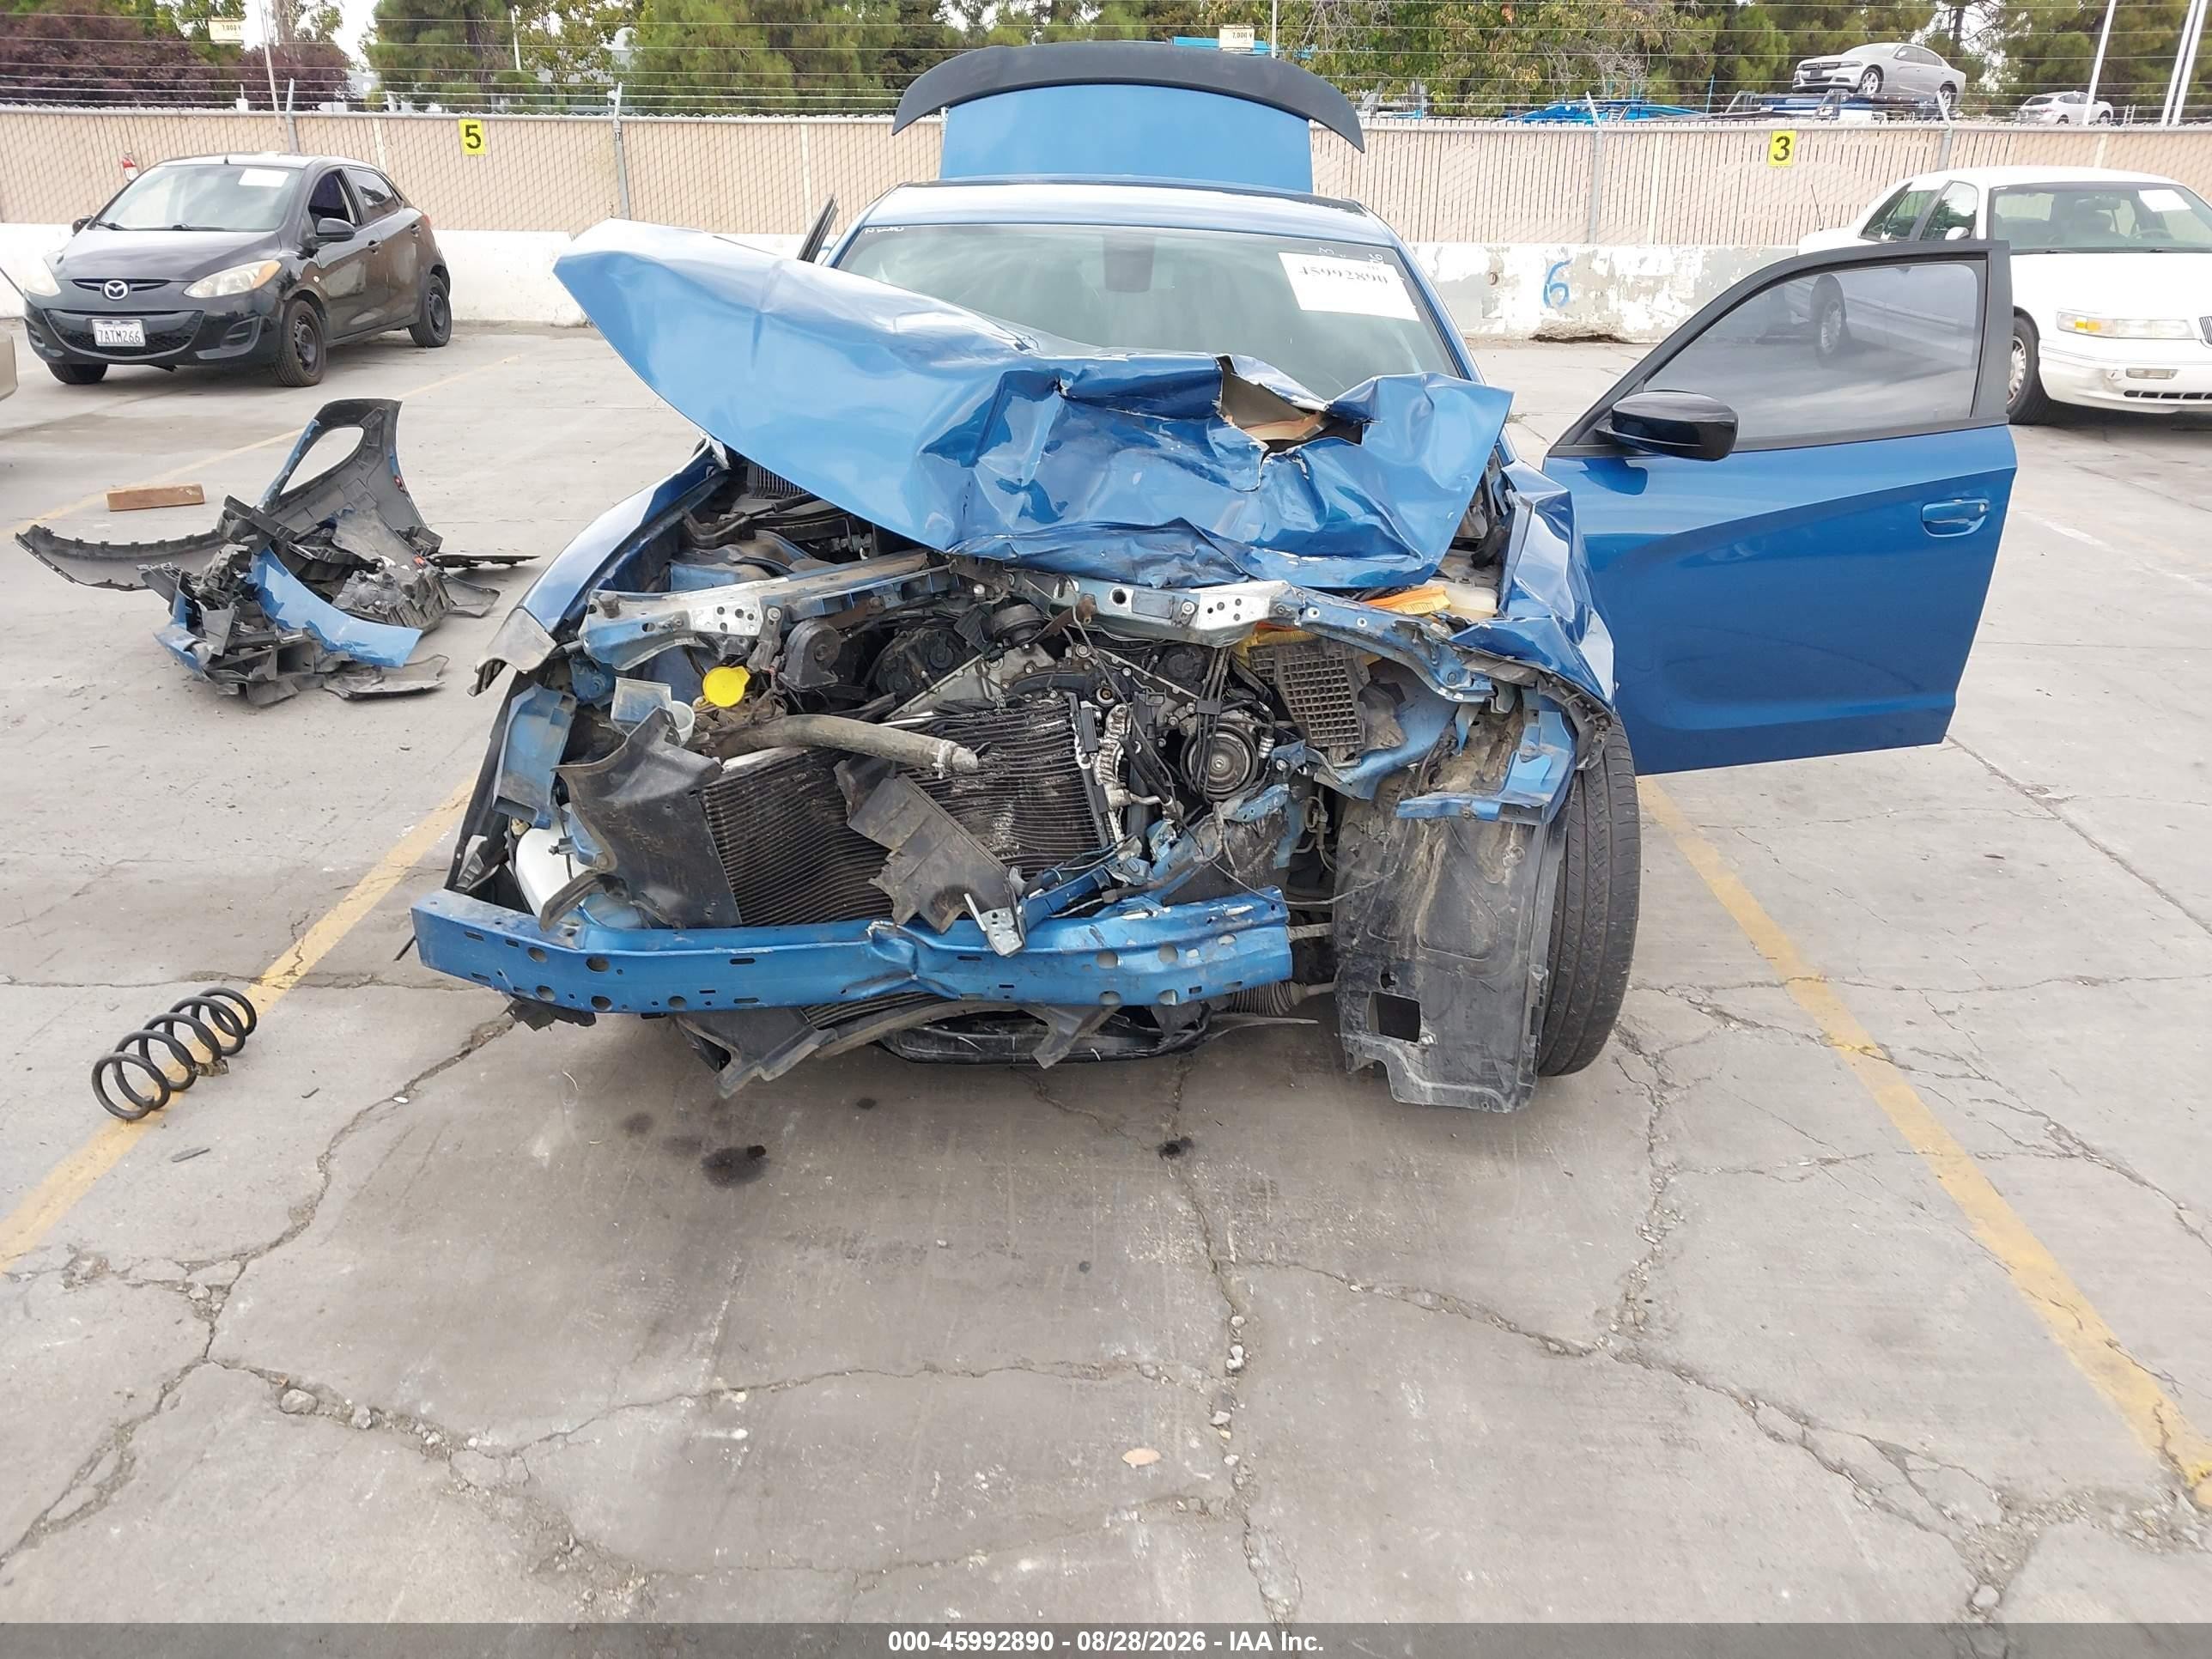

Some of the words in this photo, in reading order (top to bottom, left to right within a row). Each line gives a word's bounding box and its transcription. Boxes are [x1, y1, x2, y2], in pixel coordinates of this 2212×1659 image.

[465, 124, 482, 149] 5
[1773, 135, 1790, 161] 3
[1543, 258, 1572, 309] 6
[96, 329, 141, 343] 7ATM266
